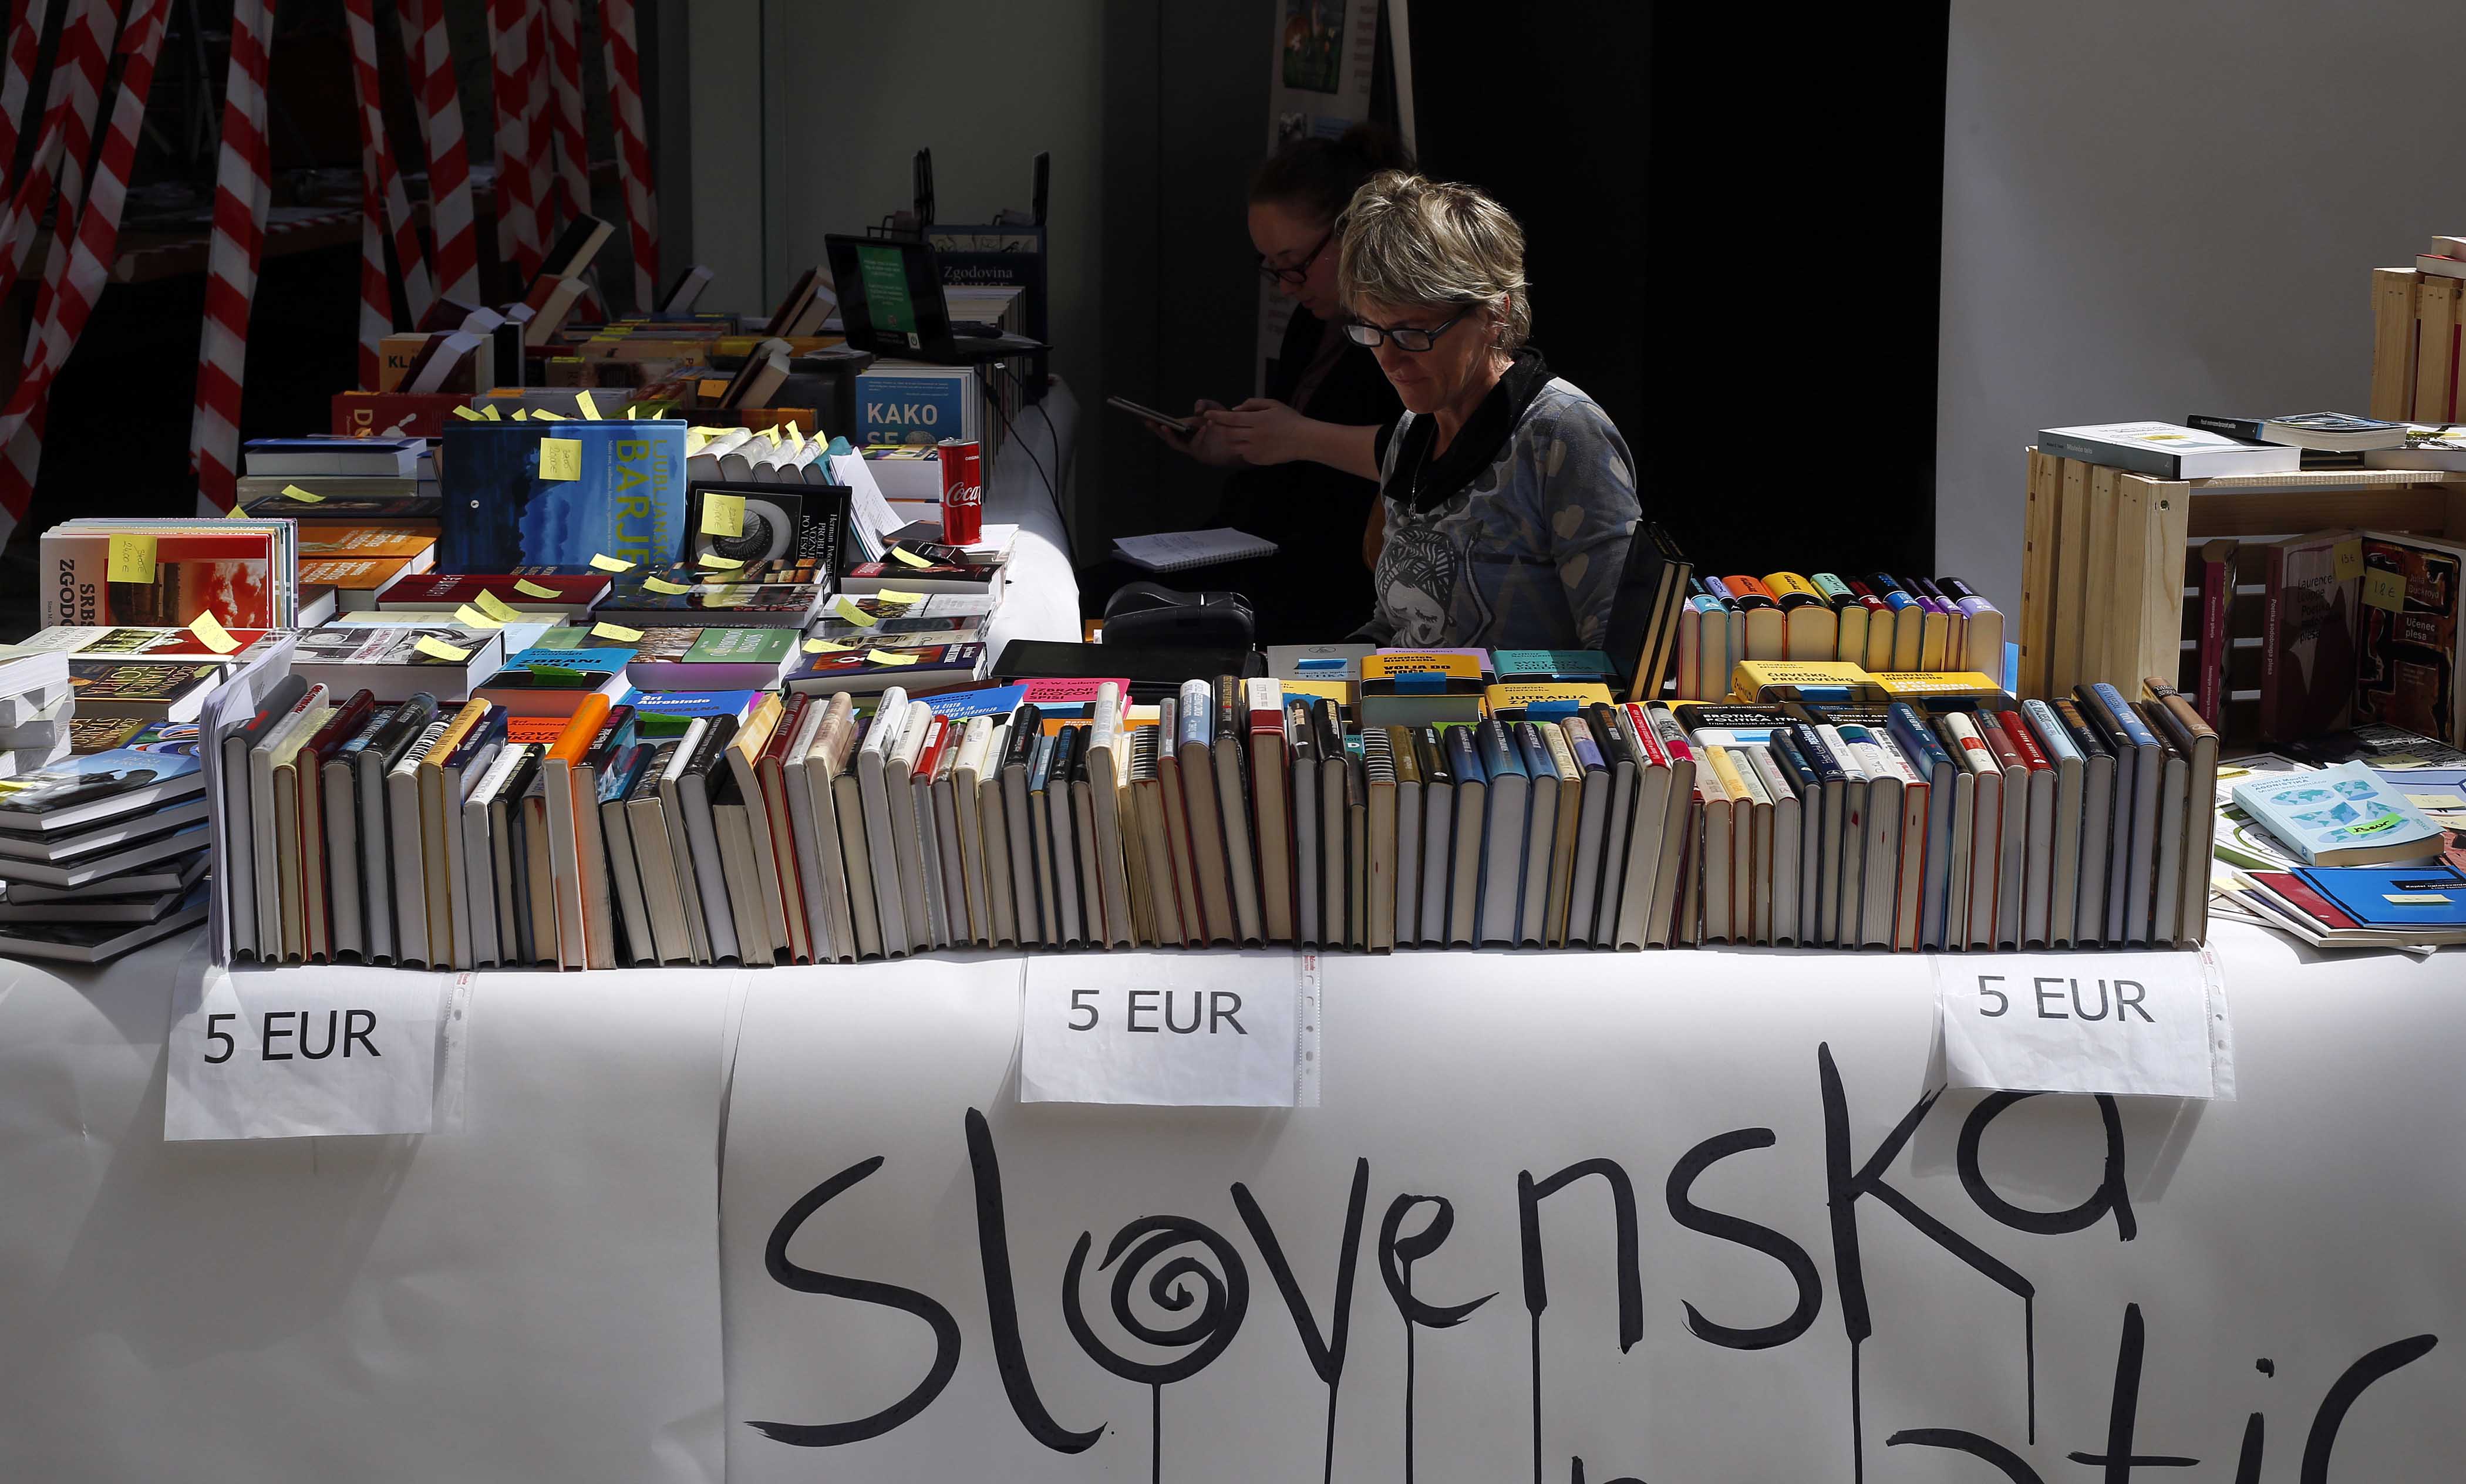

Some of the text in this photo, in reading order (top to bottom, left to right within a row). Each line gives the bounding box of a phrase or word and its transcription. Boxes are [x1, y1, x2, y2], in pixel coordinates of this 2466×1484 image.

[944, 265, 1013, 281] Zgodovina
[867, 403, 938, 425] KAKO
[801, 515, 810, 527] PO
[828, 514, 838, 542] Herman
[2406, 618, 2436, 632] Učenec
[2406, 629, 2428, 641] plesa
[78, 666, 152, 694] EGIPTA
[113, 666, 179, 695] STAREGA
[141, 666, 200, 695] ZGODOVINA
[2251, 779, 2282, 788] Chantal
[2255, 779, 2309, 791] AGONISTIKA
[1069, 990, 1247, 1034] 5 EUR
[1977, 976, 2156, 1023] 5 EUR
[205, 1010, 381, 1063] 5 EUR
[744, 1042, 2137, 1454] Slovenska
